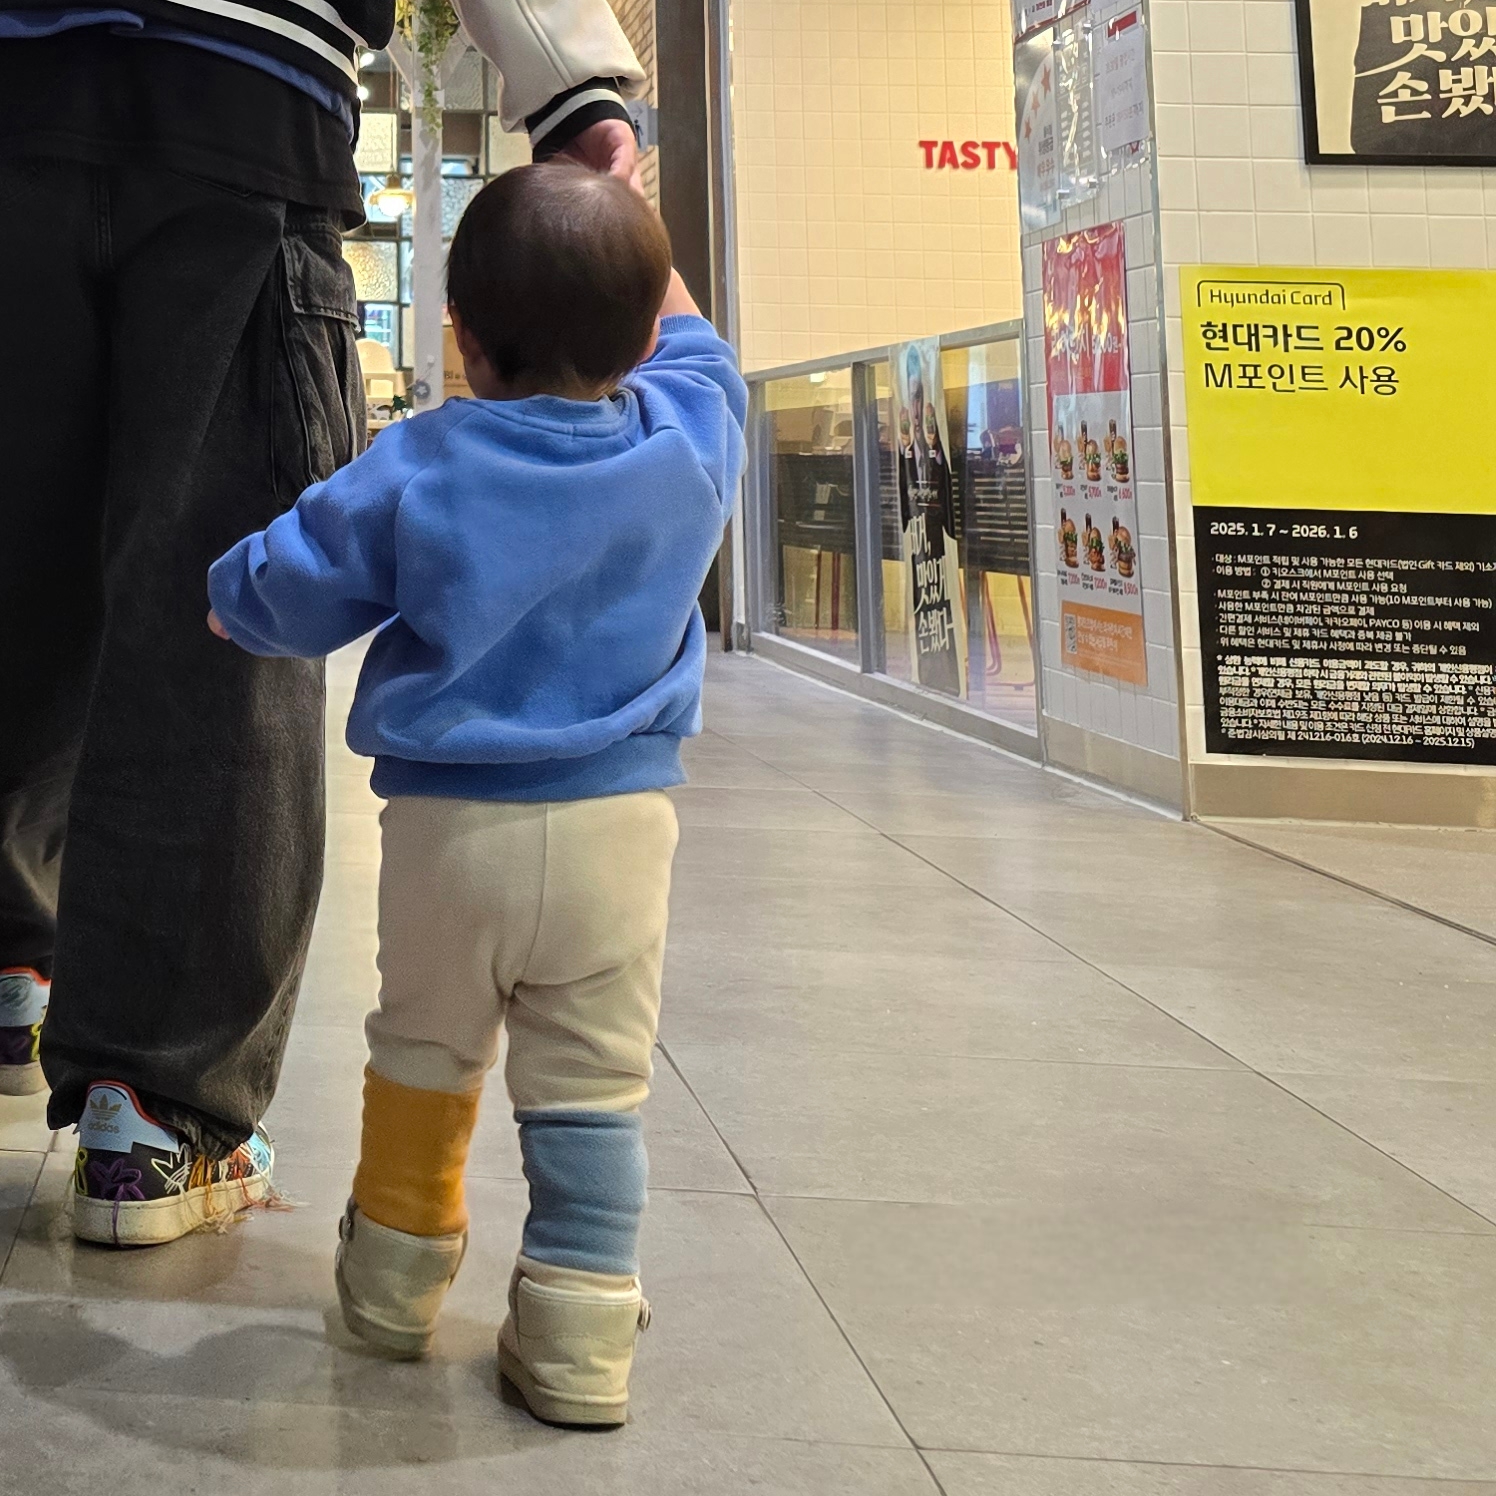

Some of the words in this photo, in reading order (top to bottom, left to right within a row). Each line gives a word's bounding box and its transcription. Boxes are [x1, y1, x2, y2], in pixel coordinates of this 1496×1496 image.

[918, 140, 1018, 170] TASTY
[1210, 289, 1286, 308] Hyundai
[1290, 290, 1332, 305] Card
[1200, 321, 1324, 352] 현대카드
[1334, 325, 1407, 352] 20%
[1204, 362, 1328, 393] M포인트
[1339, 365, 1399, 396] 사용
[1210, 522, 1248, 535] 2025.
[1252, 523, 1263, 536] 1.
[1266, 524, 1276, 537] 7
[1292, 525, 1330, 538] 2026.
[1334, 526, 1346, 539] 1.
[1348, 526, 1358, 539] 6
[1237, 554, 1270, 564] M포인트
[1301, 556, 1318, 567] 사용
[1320, 557, 1344, 567] 가능한
[1347, 558, 1363, 568] 모든
[1418, 560, 1435, 570] Gift
[1437, 561, 1453, 571] 카드
[1216, 565, 1233, 576] 이용
[1323, 568, 1356, 579] M포인트
[1358, 570, 1375, 580] 사용
[1291, 579, 1300, 590] 시
[1337, 581, 1370, 591] M포인트
[1372, 583, 1388, 593] 사용
[1218, 589, 1251, 599] M포인트
[1271, 591, 1279, 600] 시
[1351, 594, 1368, 604] 사용
[1454, 597, 1470, 608] 사용
[1219, 625, 1236, 635] 다른
[1257, 627, 1281, 636] 서비스
[1312, 628, 1328, 638] 카드
[1369, 619, 1399, 628] PAYCO
[1414, 620, 1431, 631] 이용
[1433, 621, 1442, 631] 시
[1257, 638, 1290, 649] 현대카드
[1439, 645, 1448, 655] 수
